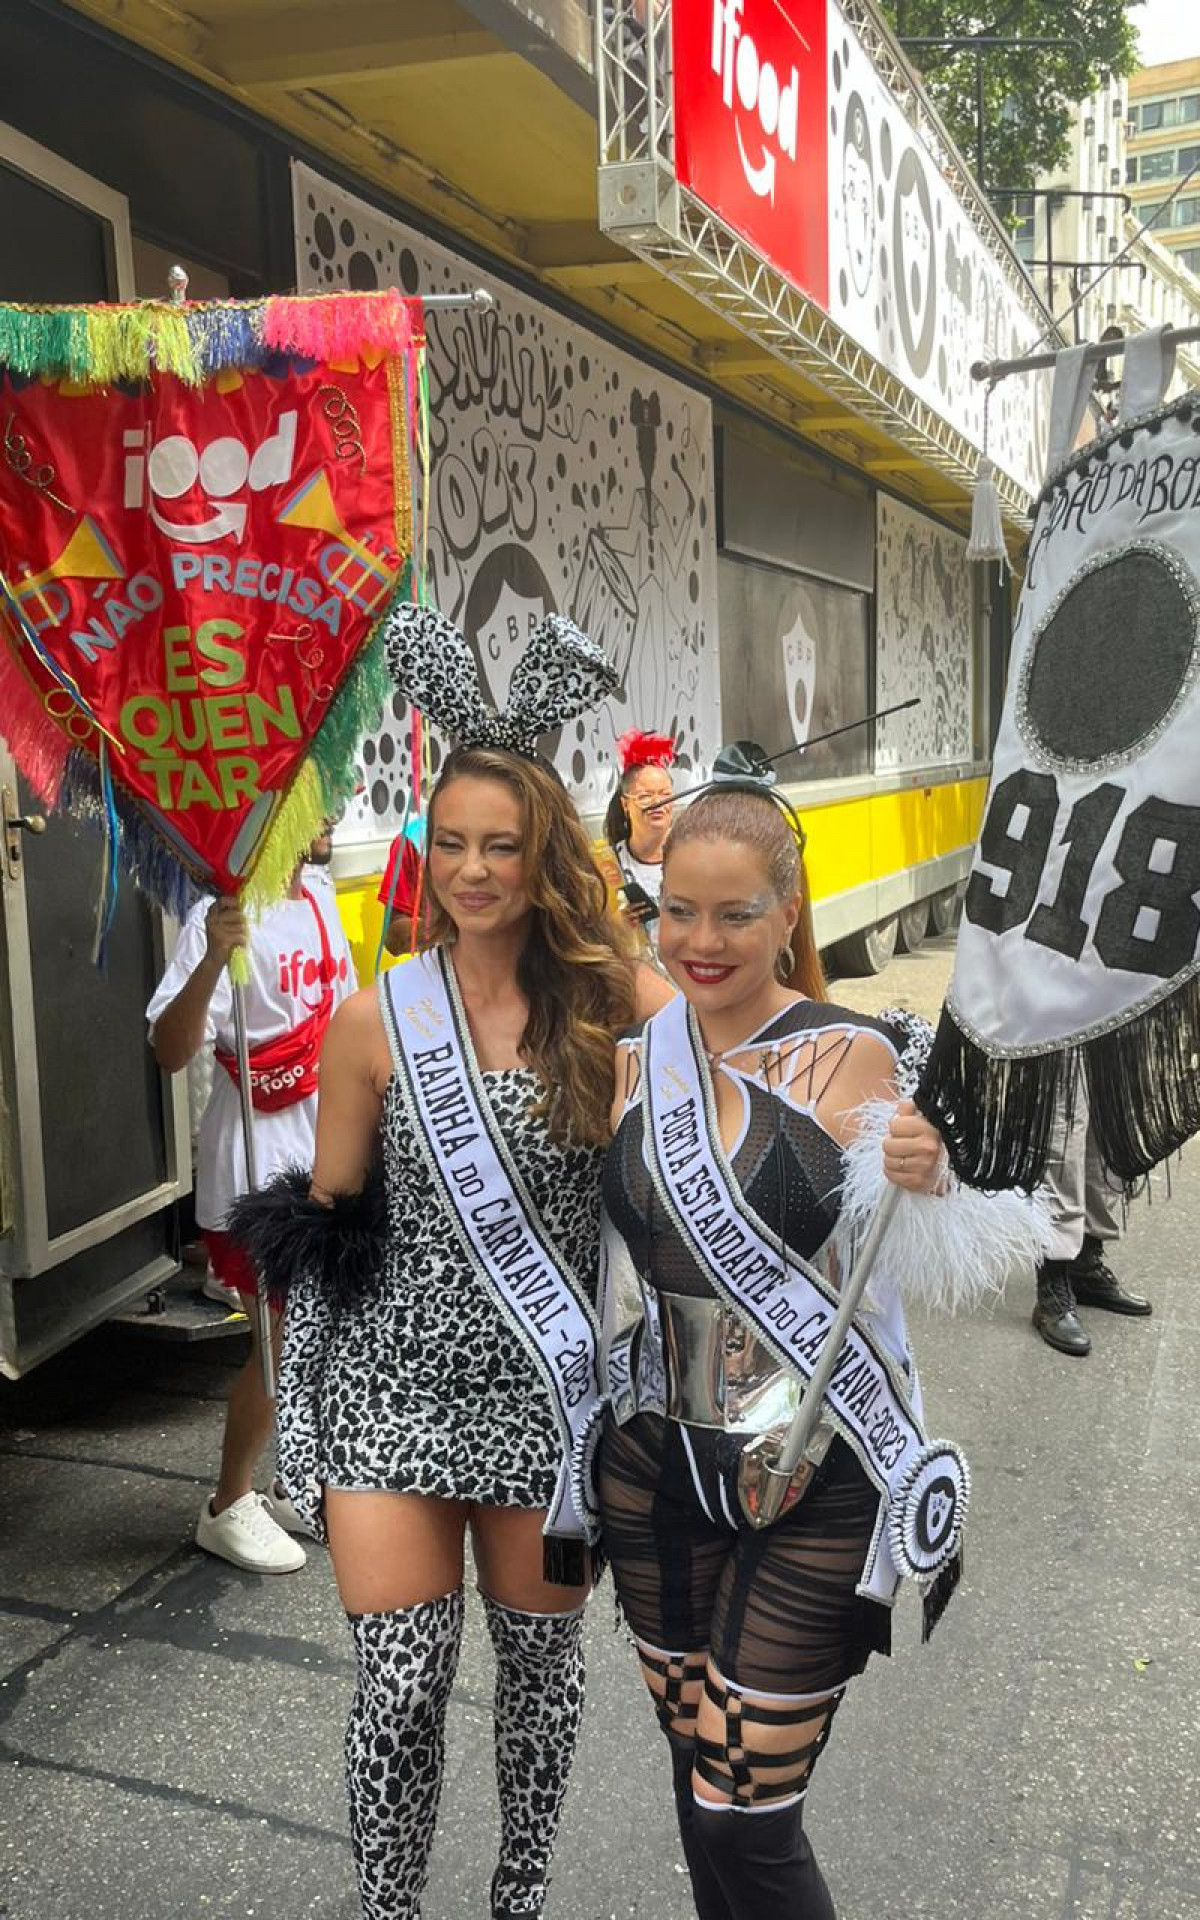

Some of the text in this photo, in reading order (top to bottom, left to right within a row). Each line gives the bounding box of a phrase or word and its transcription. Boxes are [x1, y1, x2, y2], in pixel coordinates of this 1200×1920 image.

[70, 551, 342, 664] NÃO PRECISA
[165, 617, 246, 692] ES
[119, 684, 302, 760] QUEN
[137, 755, 265, 811] TAR
[965, 767, 1200, 979] 918
[659, 1097, 703, 1176] PORTA
[413, 1041, 480, 1158] RAINHA
[450, 1160, 485, 1198] DO
[470, 1197, 570, 1337] CARNAVAL
[554, 1339, 591, 1408] 2023
[674, 1163, 786, 1306] ESTANDARTE
[764, 1296, 799, 1332] DO
